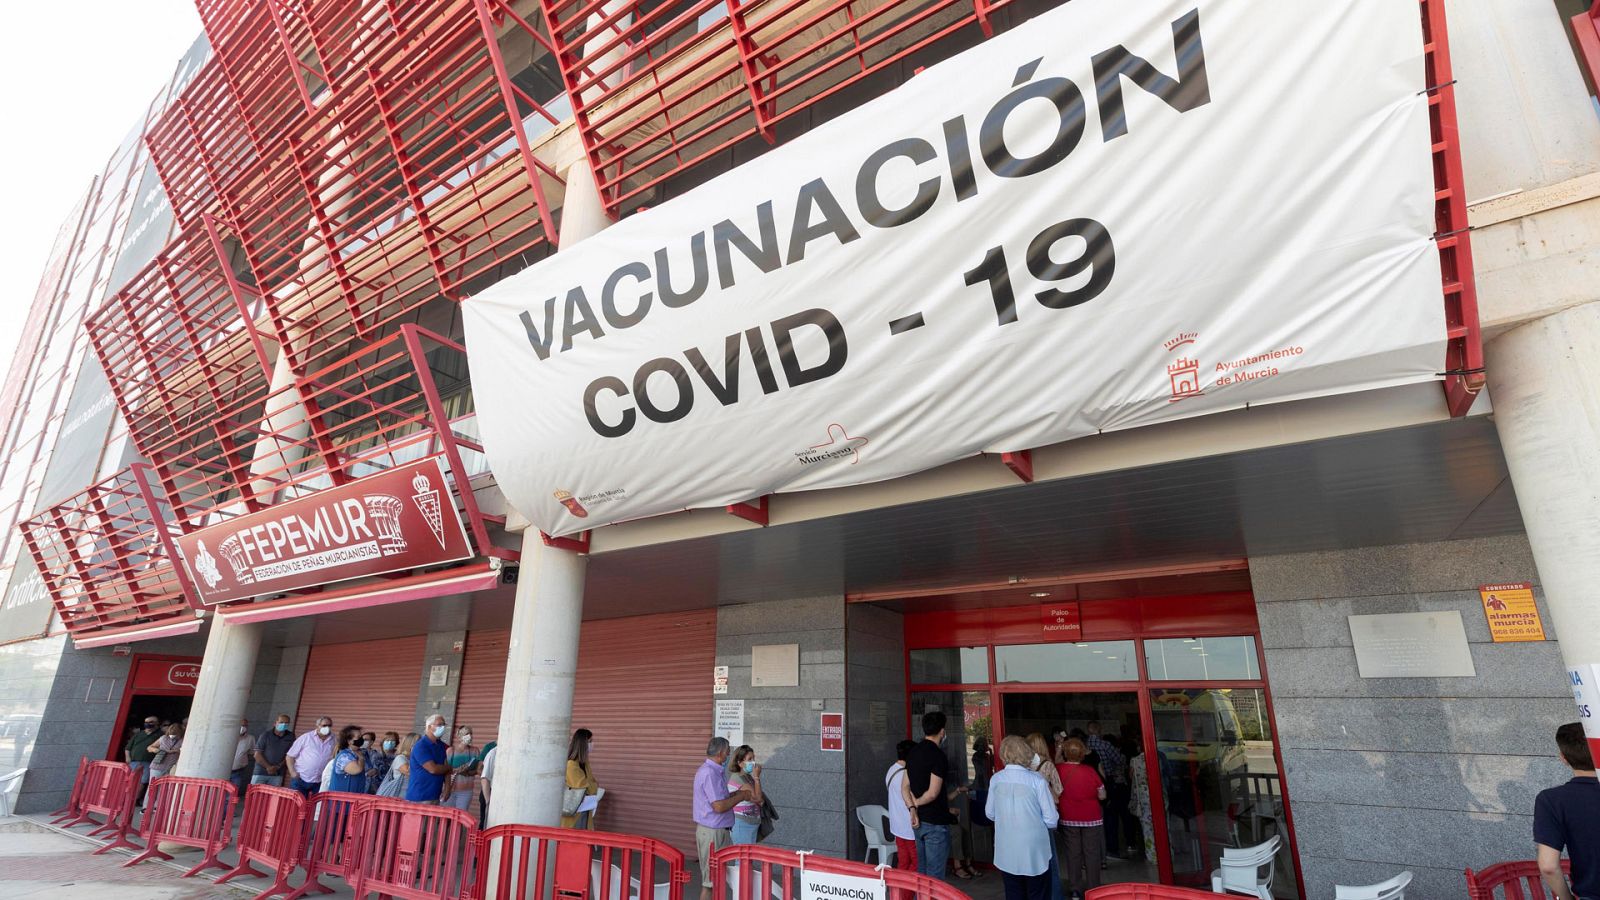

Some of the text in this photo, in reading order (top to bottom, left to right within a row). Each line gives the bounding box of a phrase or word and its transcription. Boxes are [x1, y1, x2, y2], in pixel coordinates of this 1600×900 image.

[518, 8, 1211, 361] VACUNACIÓN
[584, 308, 848, 438] COVID
[963, 217, 1116, 327] 19
[1215, 345, 1304, 374] Ayuntamiento
[1216, 366, 1280, 386] de Murcia
[798, 447, 852, 465] Murciano
[237, 498, 375, 565] FEPEMUR
[292, 561, 302, 571] DE
[302, 555, 325, 569] PEÑAS
[325, 544, 379, 564] MURCIANISTAS
[1489, 612, 1536, 620] alarmas
[1494, 618, 1535, 626] murcia
[809, 882, 874, 900] VACUNACIÓN
